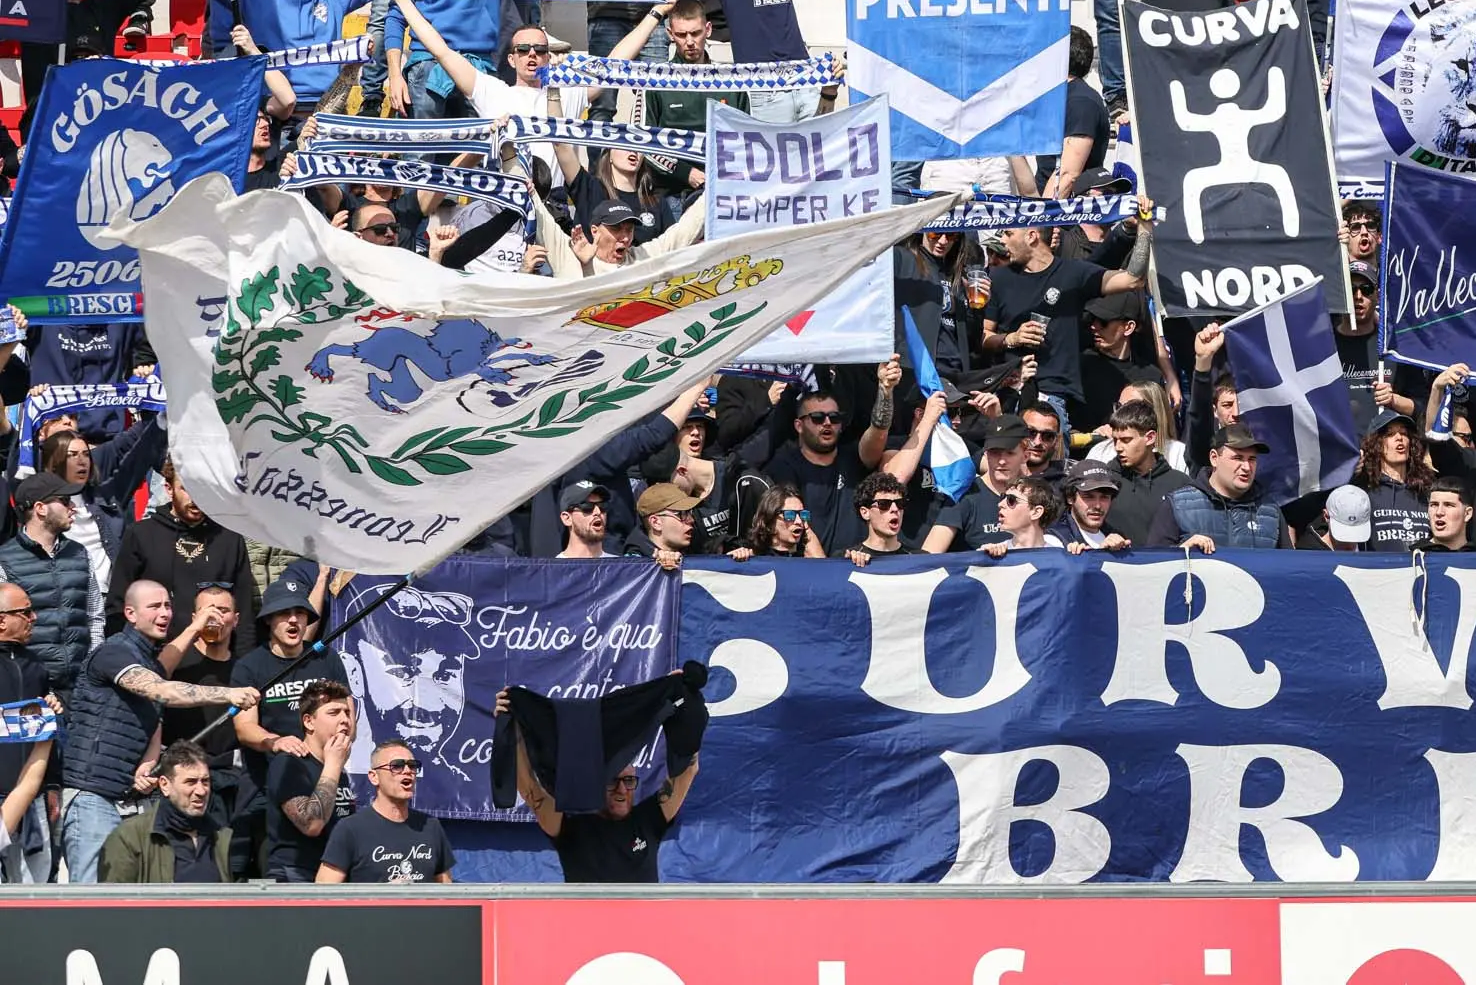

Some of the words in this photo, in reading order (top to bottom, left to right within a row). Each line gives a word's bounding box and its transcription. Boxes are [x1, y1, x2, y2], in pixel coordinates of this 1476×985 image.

[716, 122, 880, 184] EDOLO
[716, 192, 828, 226] SEMPER
[964, 213, 1015, 229] sempre
[1027, 213, 1051, 227] per
[1054, 211, 1103, 226] sempre
[1058, 195, 1139, 218] VIVE
[1180, 264, 1318, 309] NORD
[85, 392, 144, 409] Brescia
[476, 605, 577, 651] Fabio
[582, 615, 603, 647] è
[608, 621, 663, 664] qua
[371, 845, 404, 864] Curva
[408, 844, 434, 862] Nord
